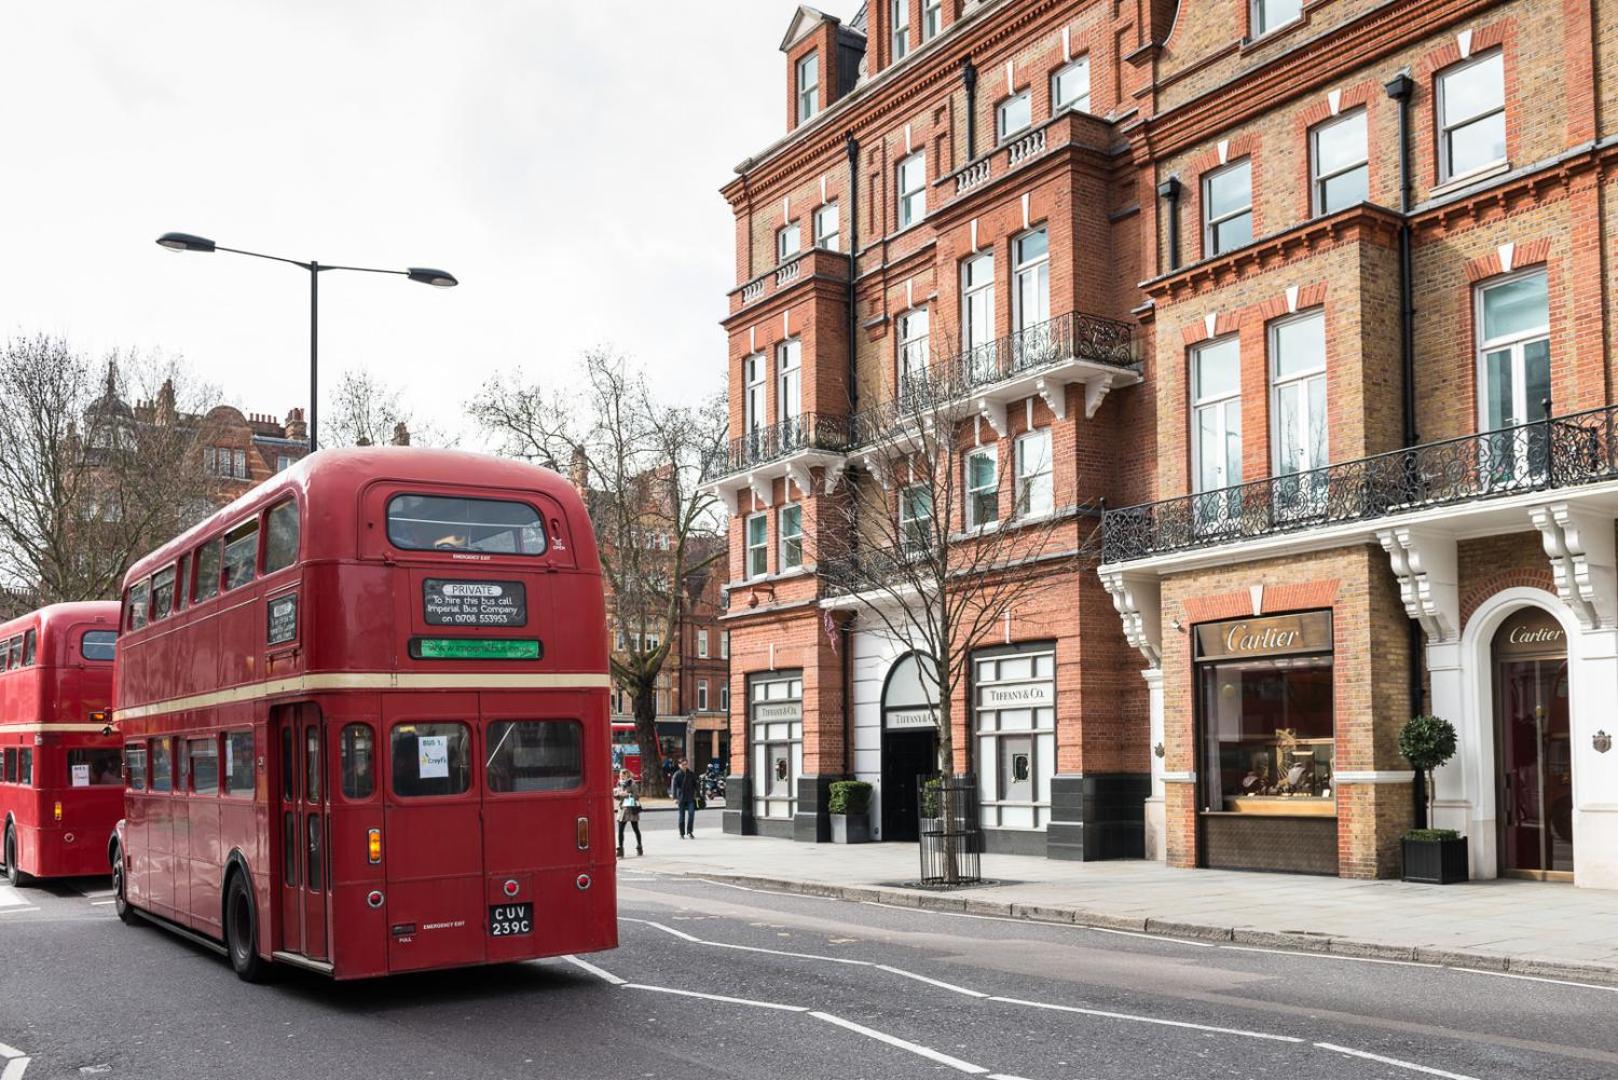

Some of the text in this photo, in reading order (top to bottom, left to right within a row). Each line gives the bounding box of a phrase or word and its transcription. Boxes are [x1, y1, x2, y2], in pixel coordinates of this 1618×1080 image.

[452, 585, 493, 595] PRIVATE
[433, 595, 512, 605] To hire this bus call
[428, 605, 518, 616] Imperial Bus Company
[455, 615, 477, 623] 01708
[480, 615, 508, 623] 553953
[1227, 624, 1299, 652] Cartier
[1509, 625, 1564, 644] Cartier
[495, 906, 525, 920] CUV
[423, 922, 453, 930] EMERGENCY
[492, 921, 530, 935] 239C
